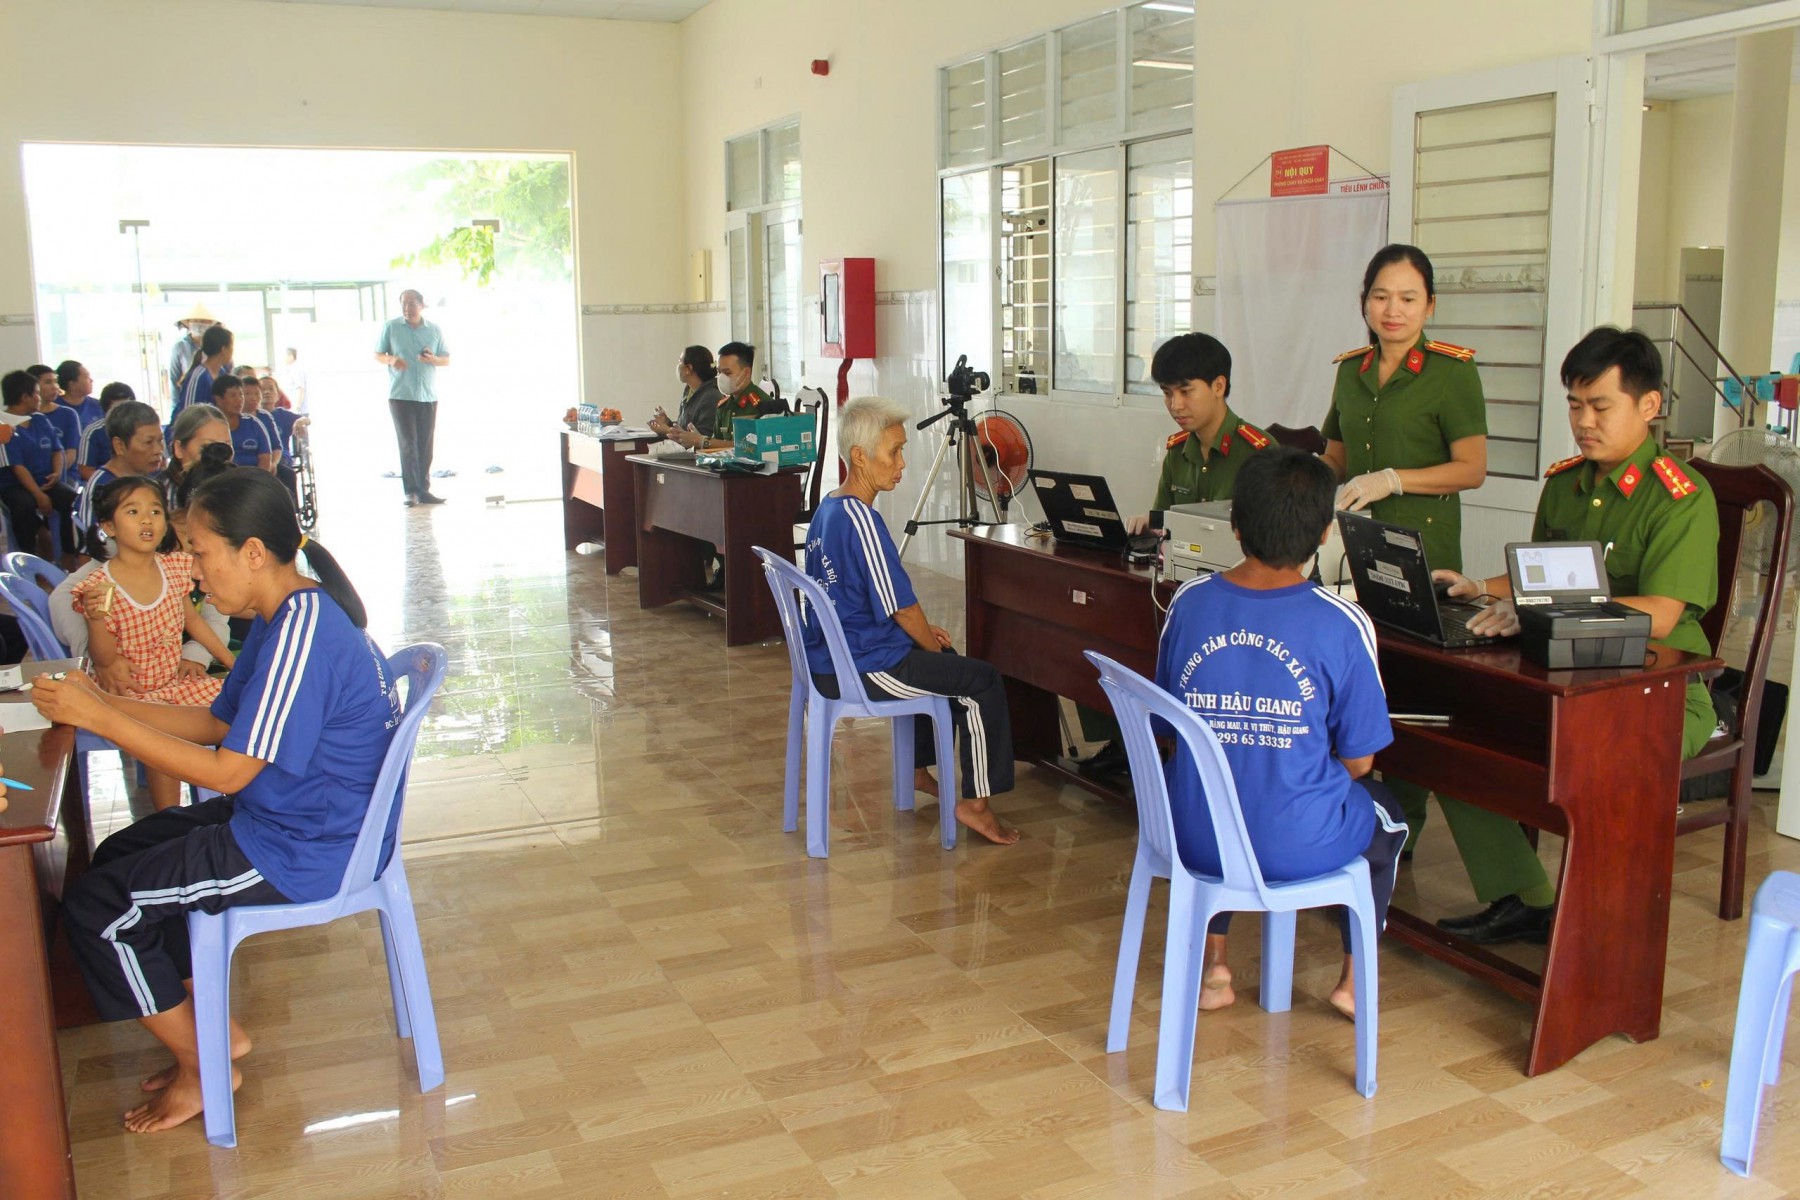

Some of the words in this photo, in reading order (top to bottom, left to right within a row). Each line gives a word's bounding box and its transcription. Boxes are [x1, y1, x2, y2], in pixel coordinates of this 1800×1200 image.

[1284, 167, 1297, 178] NỘI
[1299, 165, 1314, 176] QUY
[826, 568, 838, 583] HỘI
[1179, 652, 1202, 689] TRUNG
[1202, 634, 1227, 655] TÂM
[1230, 629, 1264, 648] CÔNG
[1266, 638, 1290, 661] TÁC
[1285, 657, 1306, 679] XÃ
[1297, 677, 1315, 701] HỘI
[1184, 687, 1217, 709] TỈNH
[1221, 691, 1252, 715] HẬU
[1255, 697, 1302, 717] GIANG
[1278, 724, 1291, 736] HẬU
[1292, 726, 1309, 735] GIANG
[1241, 733, 1255, 746] 65
[1258, 734, 1292, 749] 33332
